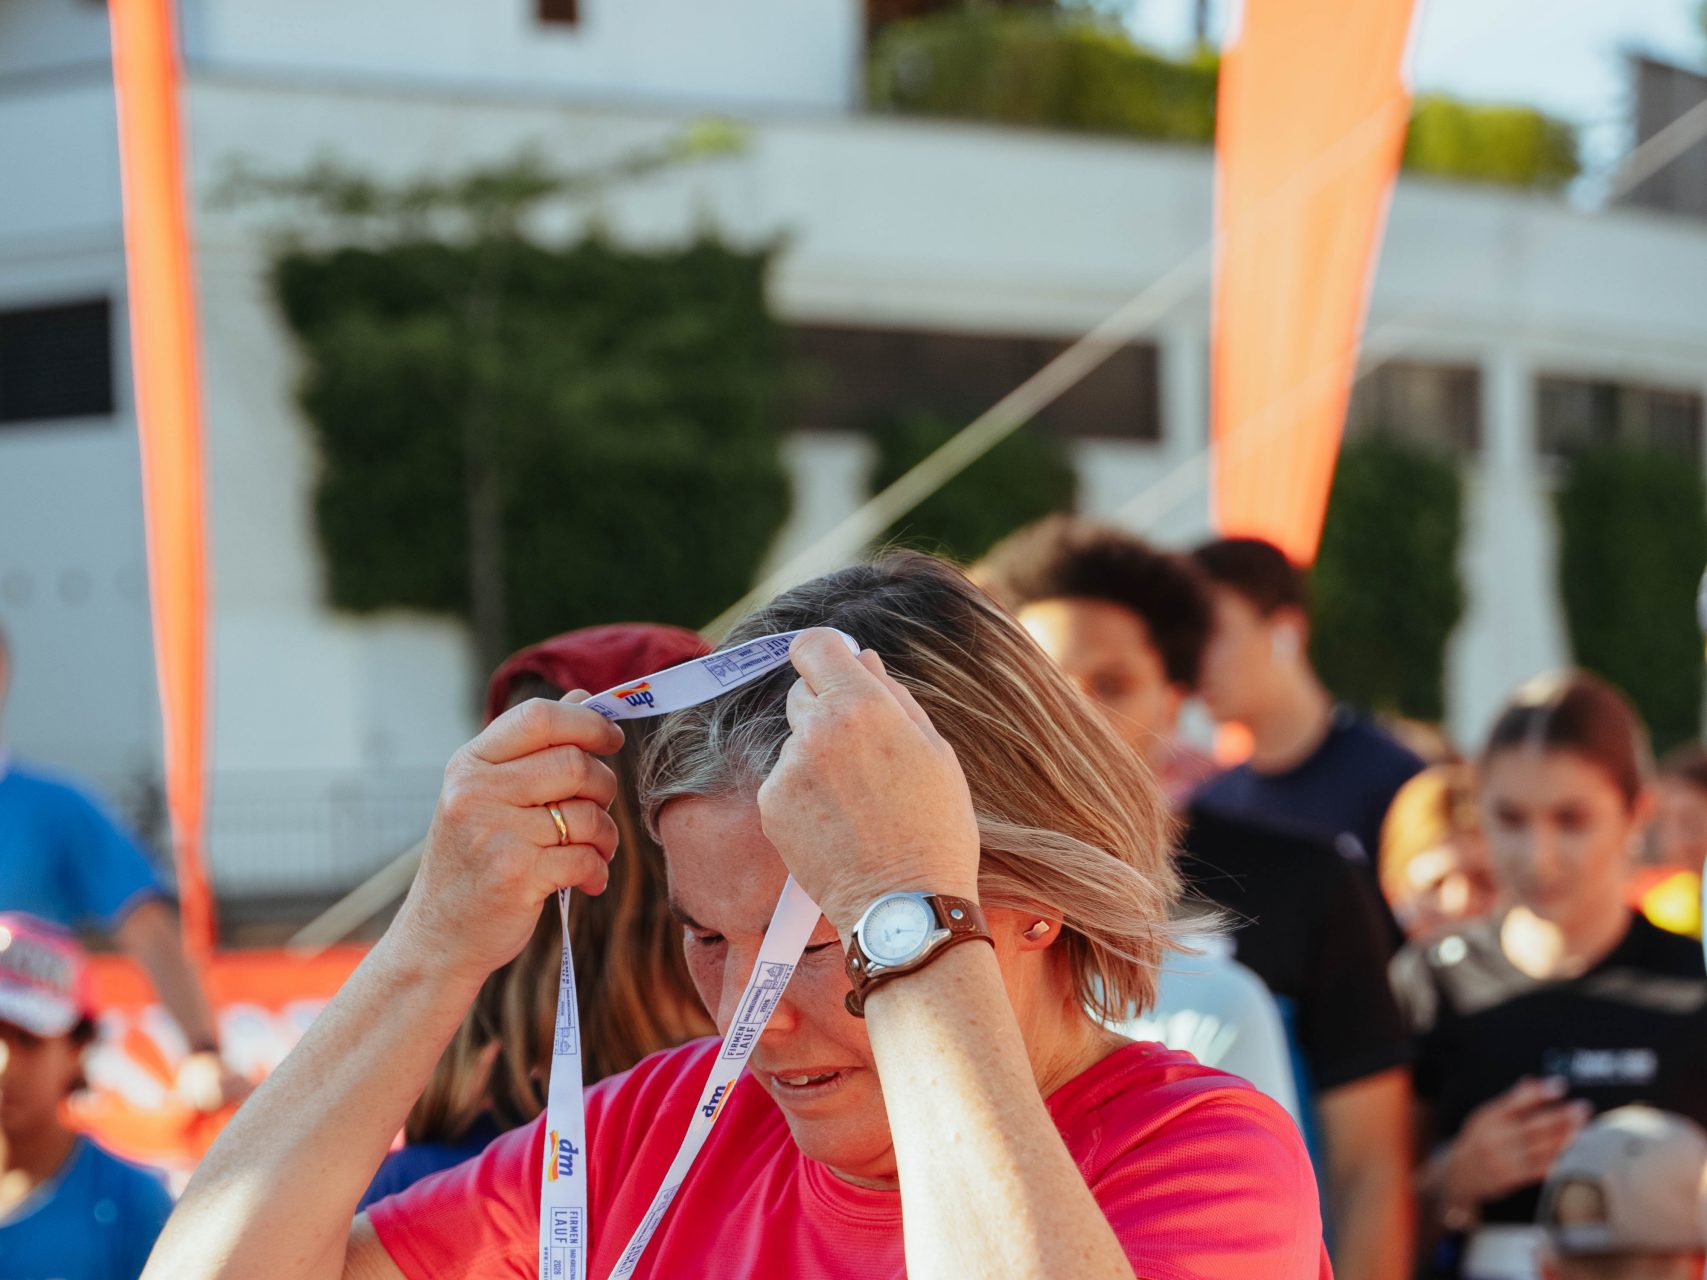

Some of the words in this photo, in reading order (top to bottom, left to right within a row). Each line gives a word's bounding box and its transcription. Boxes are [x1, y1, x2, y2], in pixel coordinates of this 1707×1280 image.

[624, 690, 655, 708] dm
[727, 1026, 746, 1056] FIRMEN
[736, 1026, 756, 1056] LAUF
[702, 1086, 727, 1118] dm
[558, 1138, 579, 1177] dm
[554, 1210, 568, 1244] LAUF
[569, 1210, 579, 1244] FIRMEN
